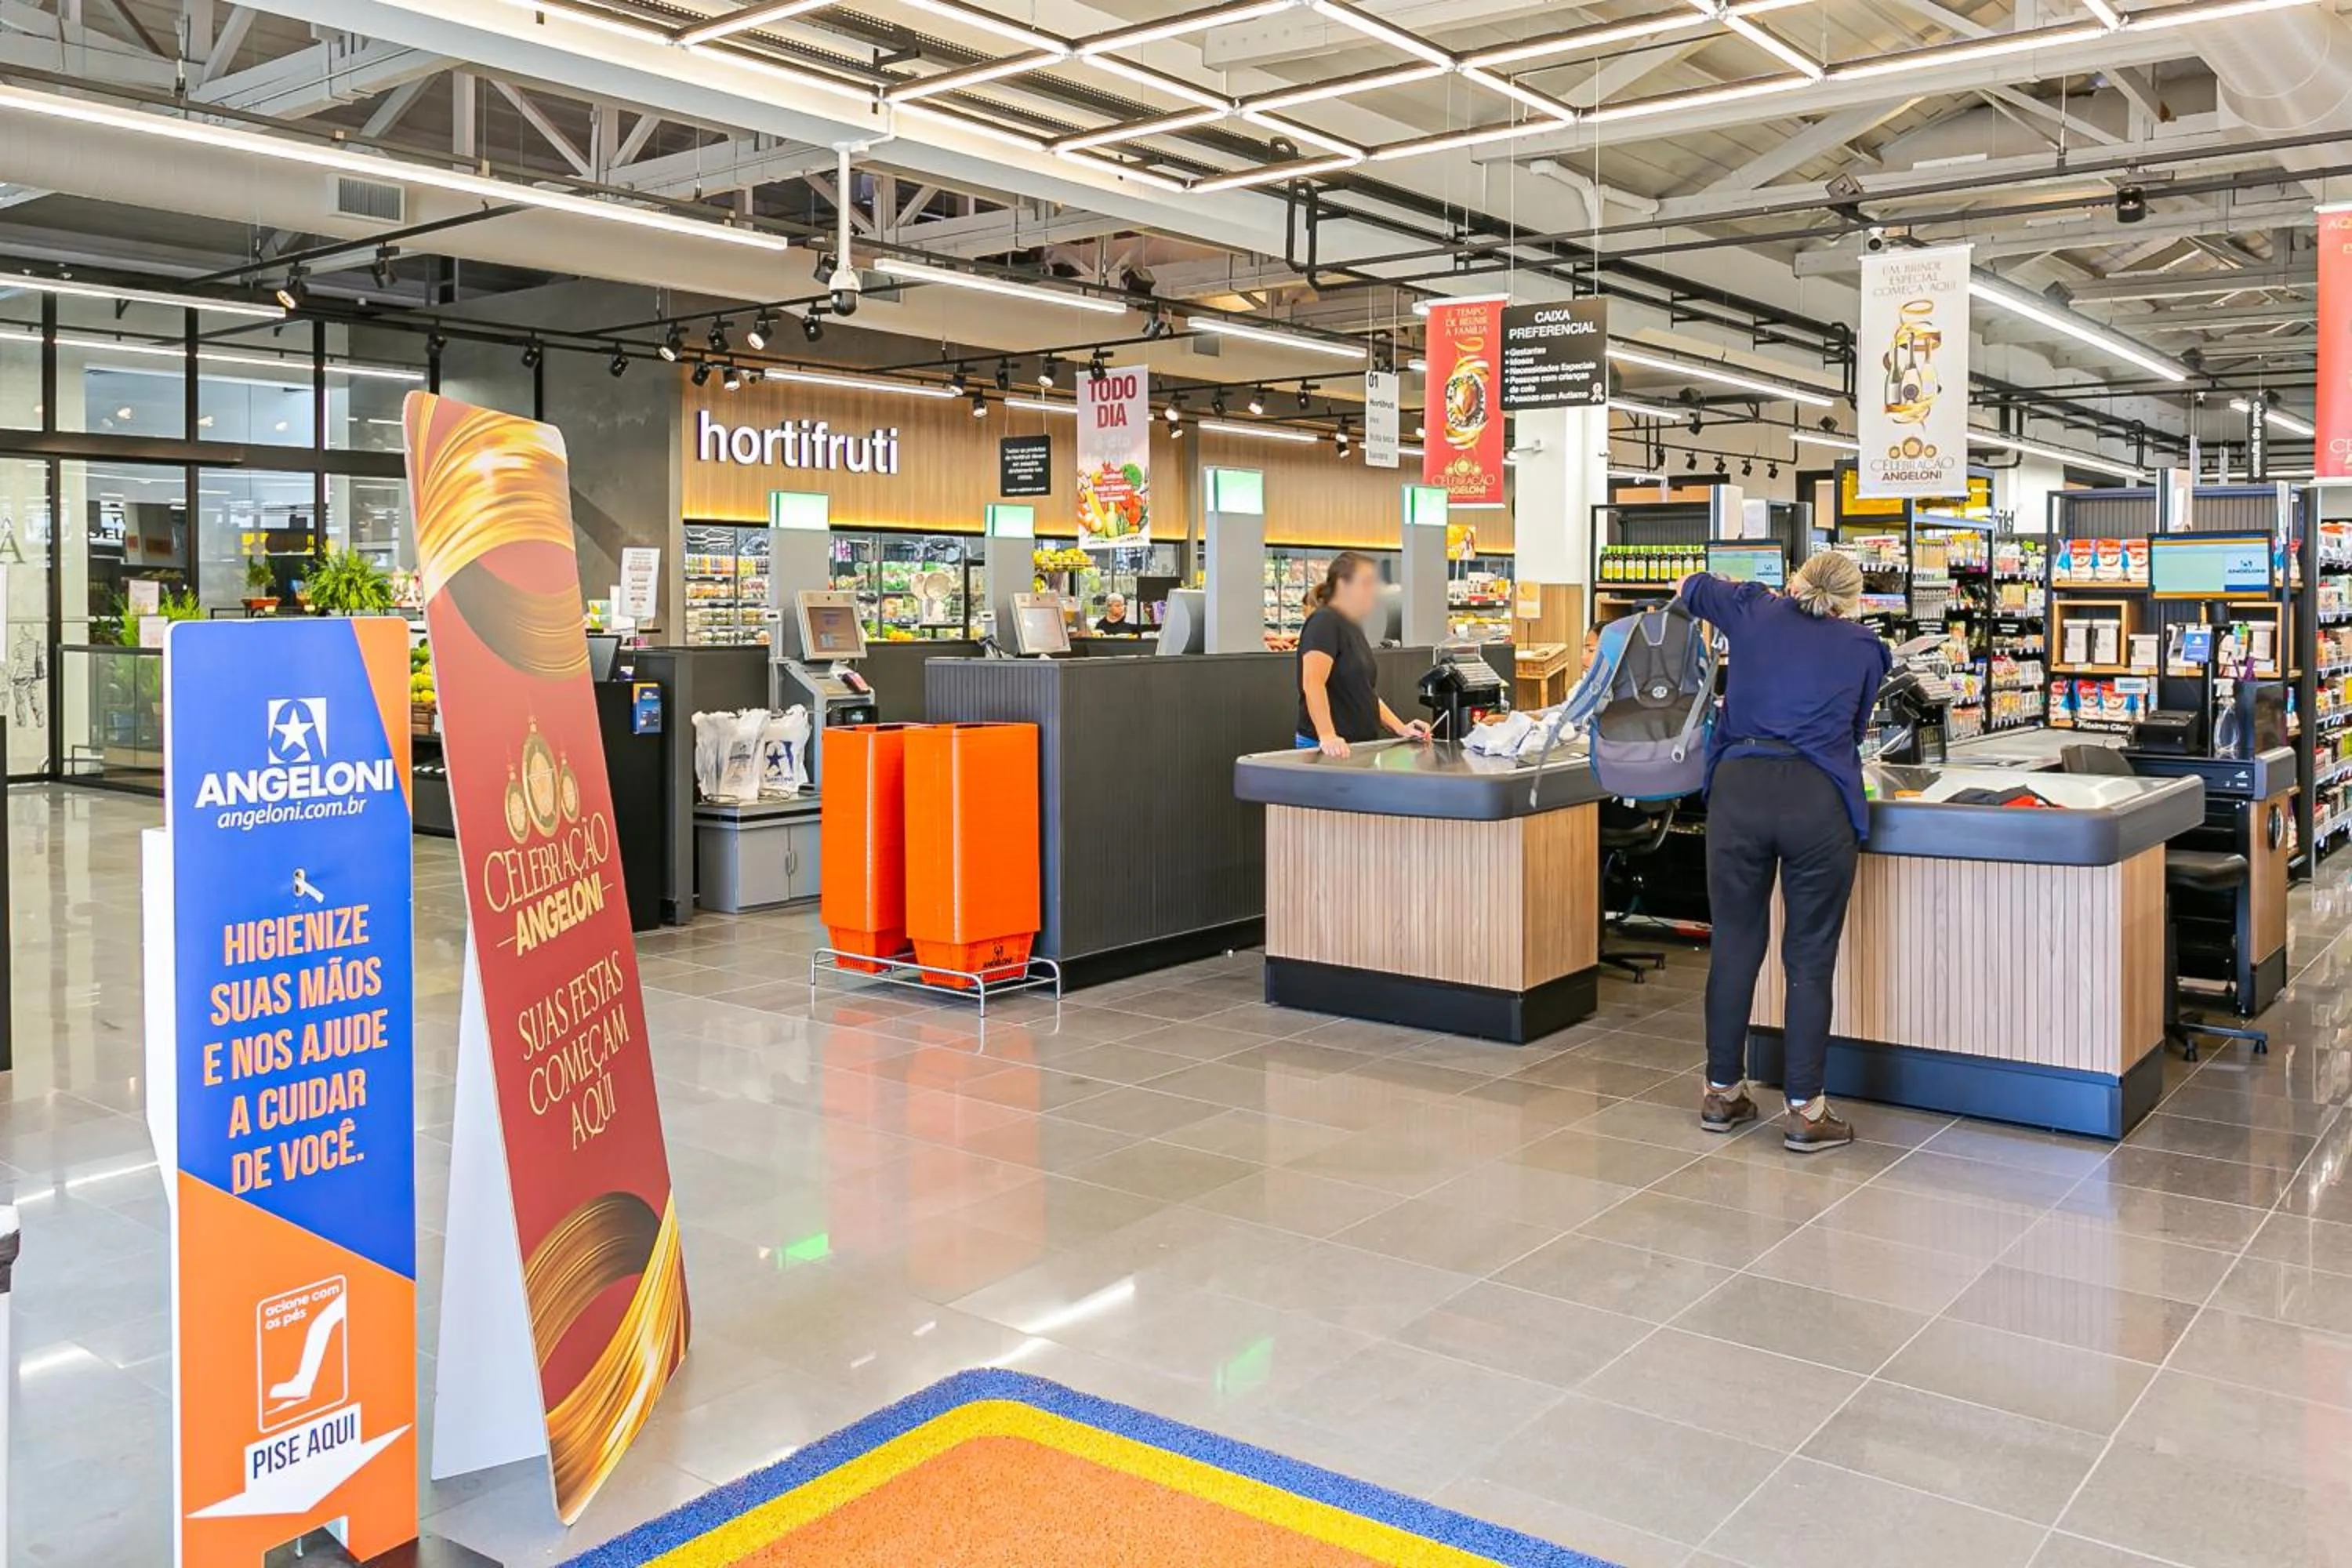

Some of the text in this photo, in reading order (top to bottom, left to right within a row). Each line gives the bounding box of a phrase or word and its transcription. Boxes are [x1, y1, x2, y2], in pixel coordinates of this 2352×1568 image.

[1889, 273, 1938, 285] ESPECIAL
[1904, 261, 1942, 273] BRINDE
[1873, 281, 1957, 297] COMEÇA AQUI
[1508, 321, 1597, 339] PREFERENCIAL
[1534, 309, 1570, 324] CAIXA
[1509, 347, 1547, 357] Gestantes
[1509, 358, 1534, 366] Idosos
[1368, 373, 1379, 389] 01
[1509, 361, 1596, 375] Necessidades Especiais
[1509, 375, 1540, 384] Pessoas
[1088, 375, 1137, 402] TODO
[1508, 384, 1537, 394] de colo
[1509, 391, 1589, 403] Pessoas com Autismo
[1097, 403, 1127, 428] DIA
[698, 410, 898, 474] hortifruti
[2252, 401, 2263, 477] consulta de preço
[1870, 456, 1955, 471] CELEBRAÇÃO
[1882, 470, 1942, 481] ANGELONI
[194, 758, 394, 809] ANGELONI
[217, 797, 367, 831] angeloni.com.br
[484, 812, 610, 913] CELEBRAÇÃO
[517, 870, 605, 957] ANGELONI
[223, 904, 370, 967] HIGIENIZE
[210, 956, 383, 1027] SUAS MÃOS
[517, 949, 624, 1061] SUAS FESTAS
[202, 1007, 389, 1087] E NOS AJUDE
[528, 1003, 630, 1116] COMEÇAM
[227, 1068, 367, 1139] A CUIDAR
[572, 1072, 618, 1151] AQUI
[230, 1117, 365, 1196] DE VOCÊ.
[265, 1284, 340, 1316] acione com
[264, 1307, 307, 1330] os pés
[252, 1412, 355, 1479] PISE AQUI
